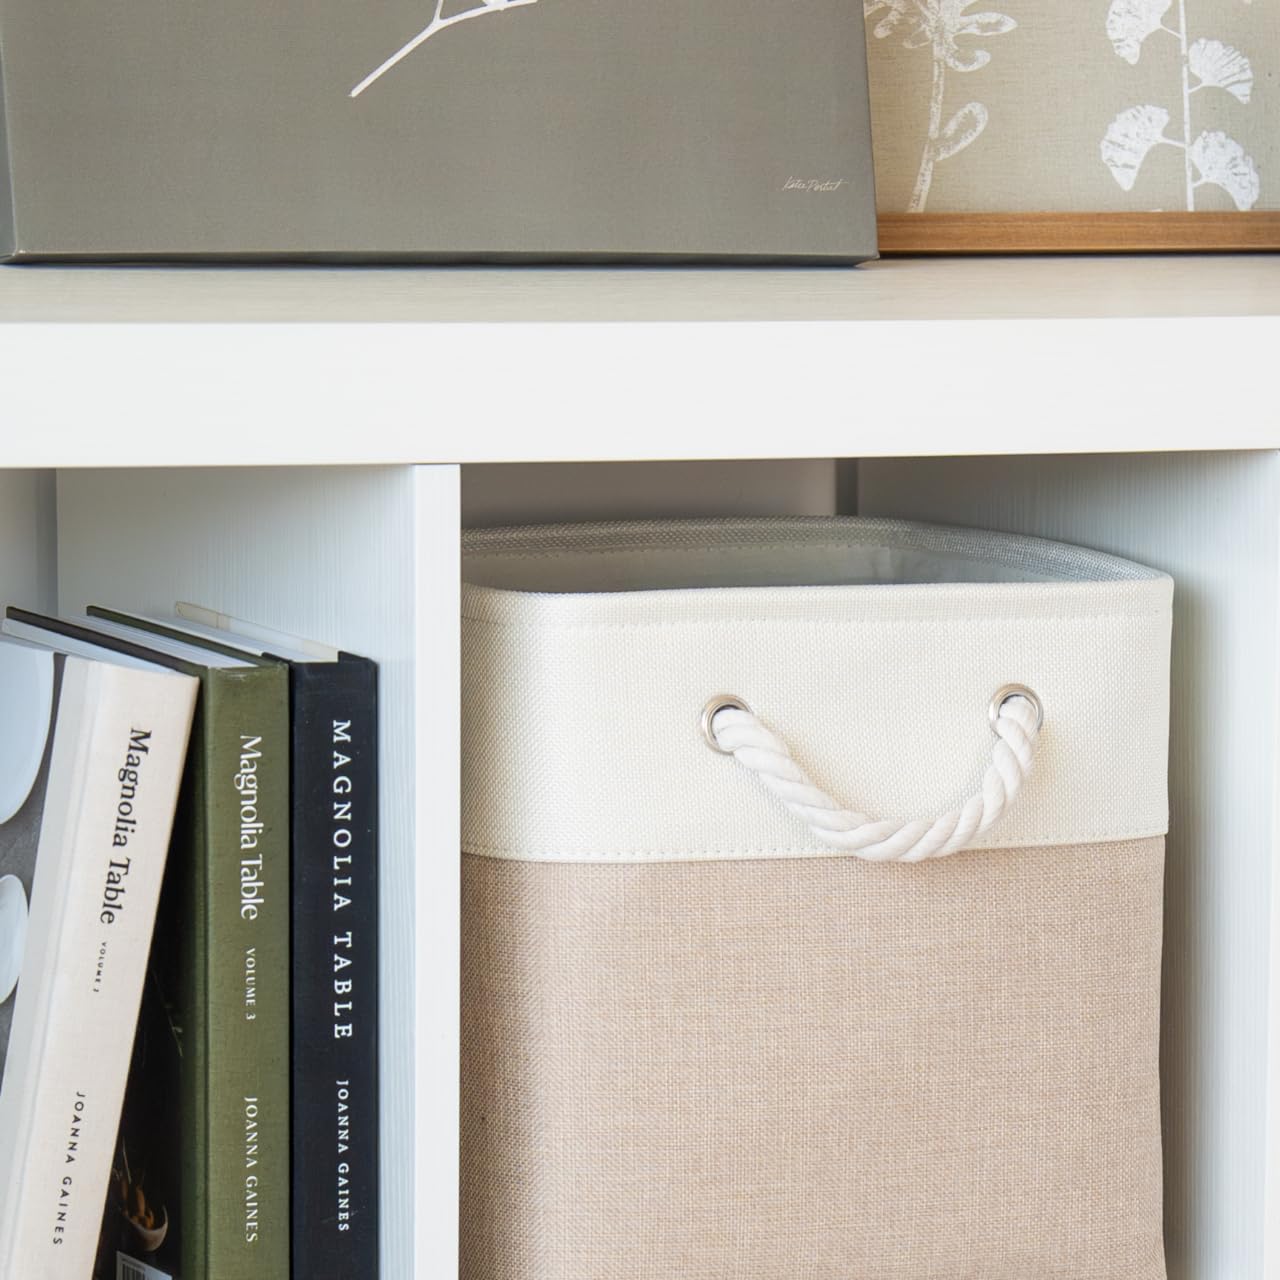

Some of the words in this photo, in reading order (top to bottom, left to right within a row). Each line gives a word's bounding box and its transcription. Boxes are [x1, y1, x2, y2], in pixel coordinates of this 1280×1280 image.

[112, 728, 152, 848] Magnolia
[234, 735, 264, 849] Magnolia
[333, 720, 352, 911] MAGNOLIA
[100, 856, 131, 925] Table
[240, 854, 264, 920] Table
[246, 948, 256, 1006] VOLUME
[333, 932, 352, 1039] TABLE
[246, 1012, 256, 1020] 3
[65, 1091, 86, 1164] JOANNA
[245, 1097, 258, 1168] JOANNA
[336, 1080, 349, 1154] JOANNA
[53, 1176, 72, 1245] GAINES
[245, 1176, 258, 1243] GAINES
[338, 1163, 349, 1232] GAINES
